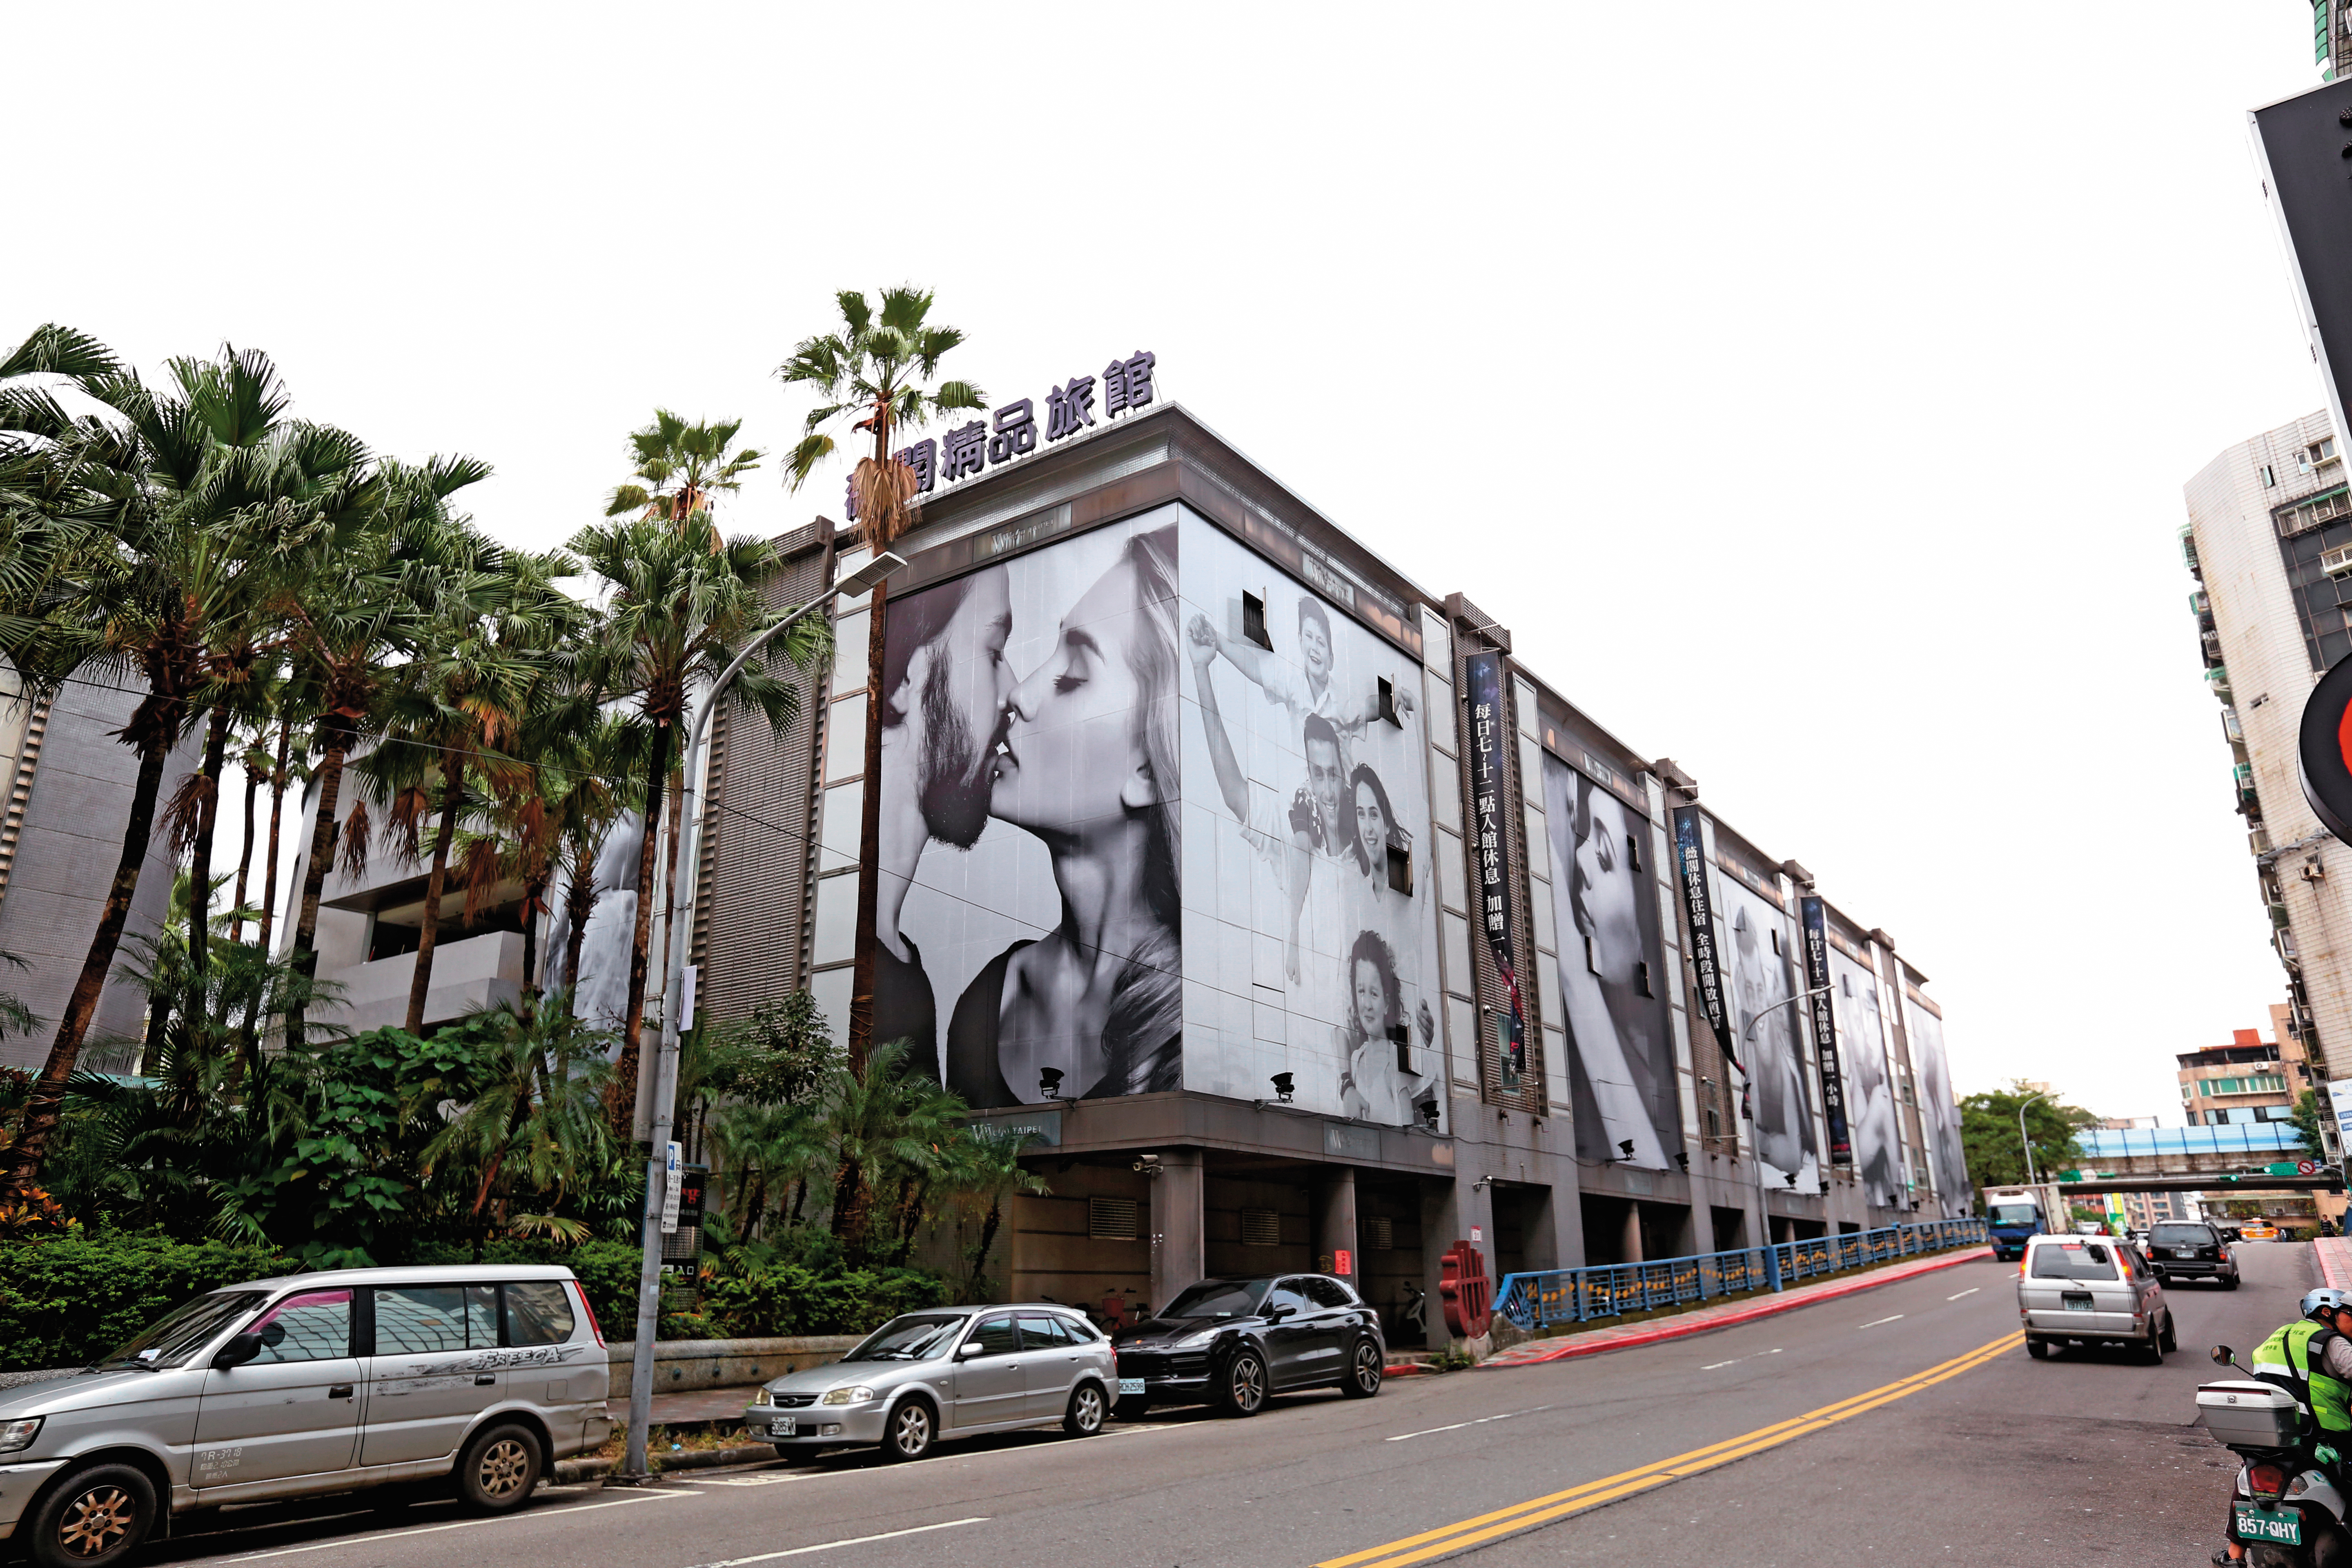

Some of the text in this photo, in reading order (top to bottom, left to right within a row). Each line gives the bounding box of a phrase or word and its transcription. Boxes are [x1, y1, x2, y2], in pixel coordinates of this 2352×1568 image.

[845, 350, 1156, 522] 閣精品旅館
[1684, 846, 1706, 926] 薇閣休息住宿
[1012, 1125, 1041, 1135] TAIPEI
[669, 1148, 674, 1167] P
[677, 1265, 694, 1275] 入口
[479, 1346, 562, 1369] FREECA
[2238, 1517, 2297, 1539] 857-QHY
